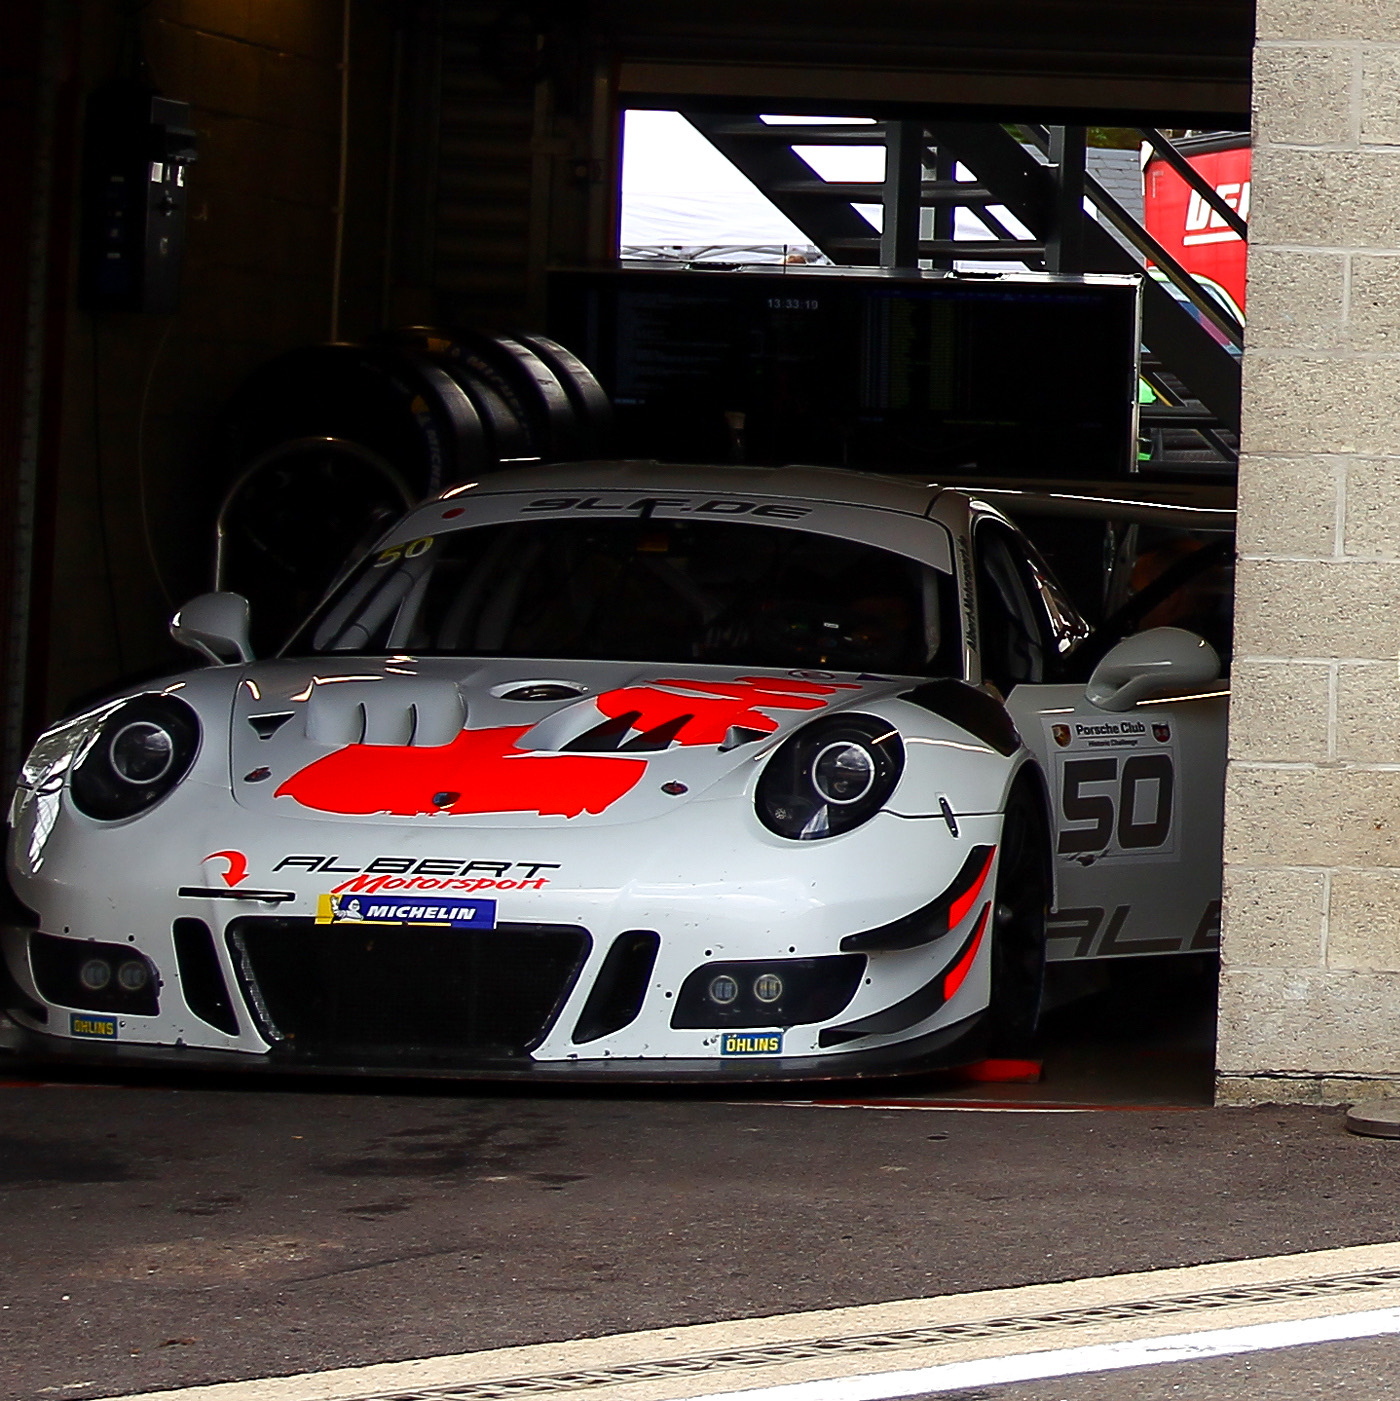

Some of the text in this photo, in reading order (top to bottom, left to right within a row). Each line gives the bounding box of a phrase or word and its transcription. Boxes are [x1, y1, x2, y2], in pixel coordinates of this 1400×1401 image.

[373, 536, 435, 568] 50
[1076, 721, 1146, 735] Porsche Club
[1058, 754, 1174, 854] 50
[272, 855, 563, 879] ALBERT
[331, 873, 551, 894] Motorsport
[366, 905, 477, 920] MICHELIN
